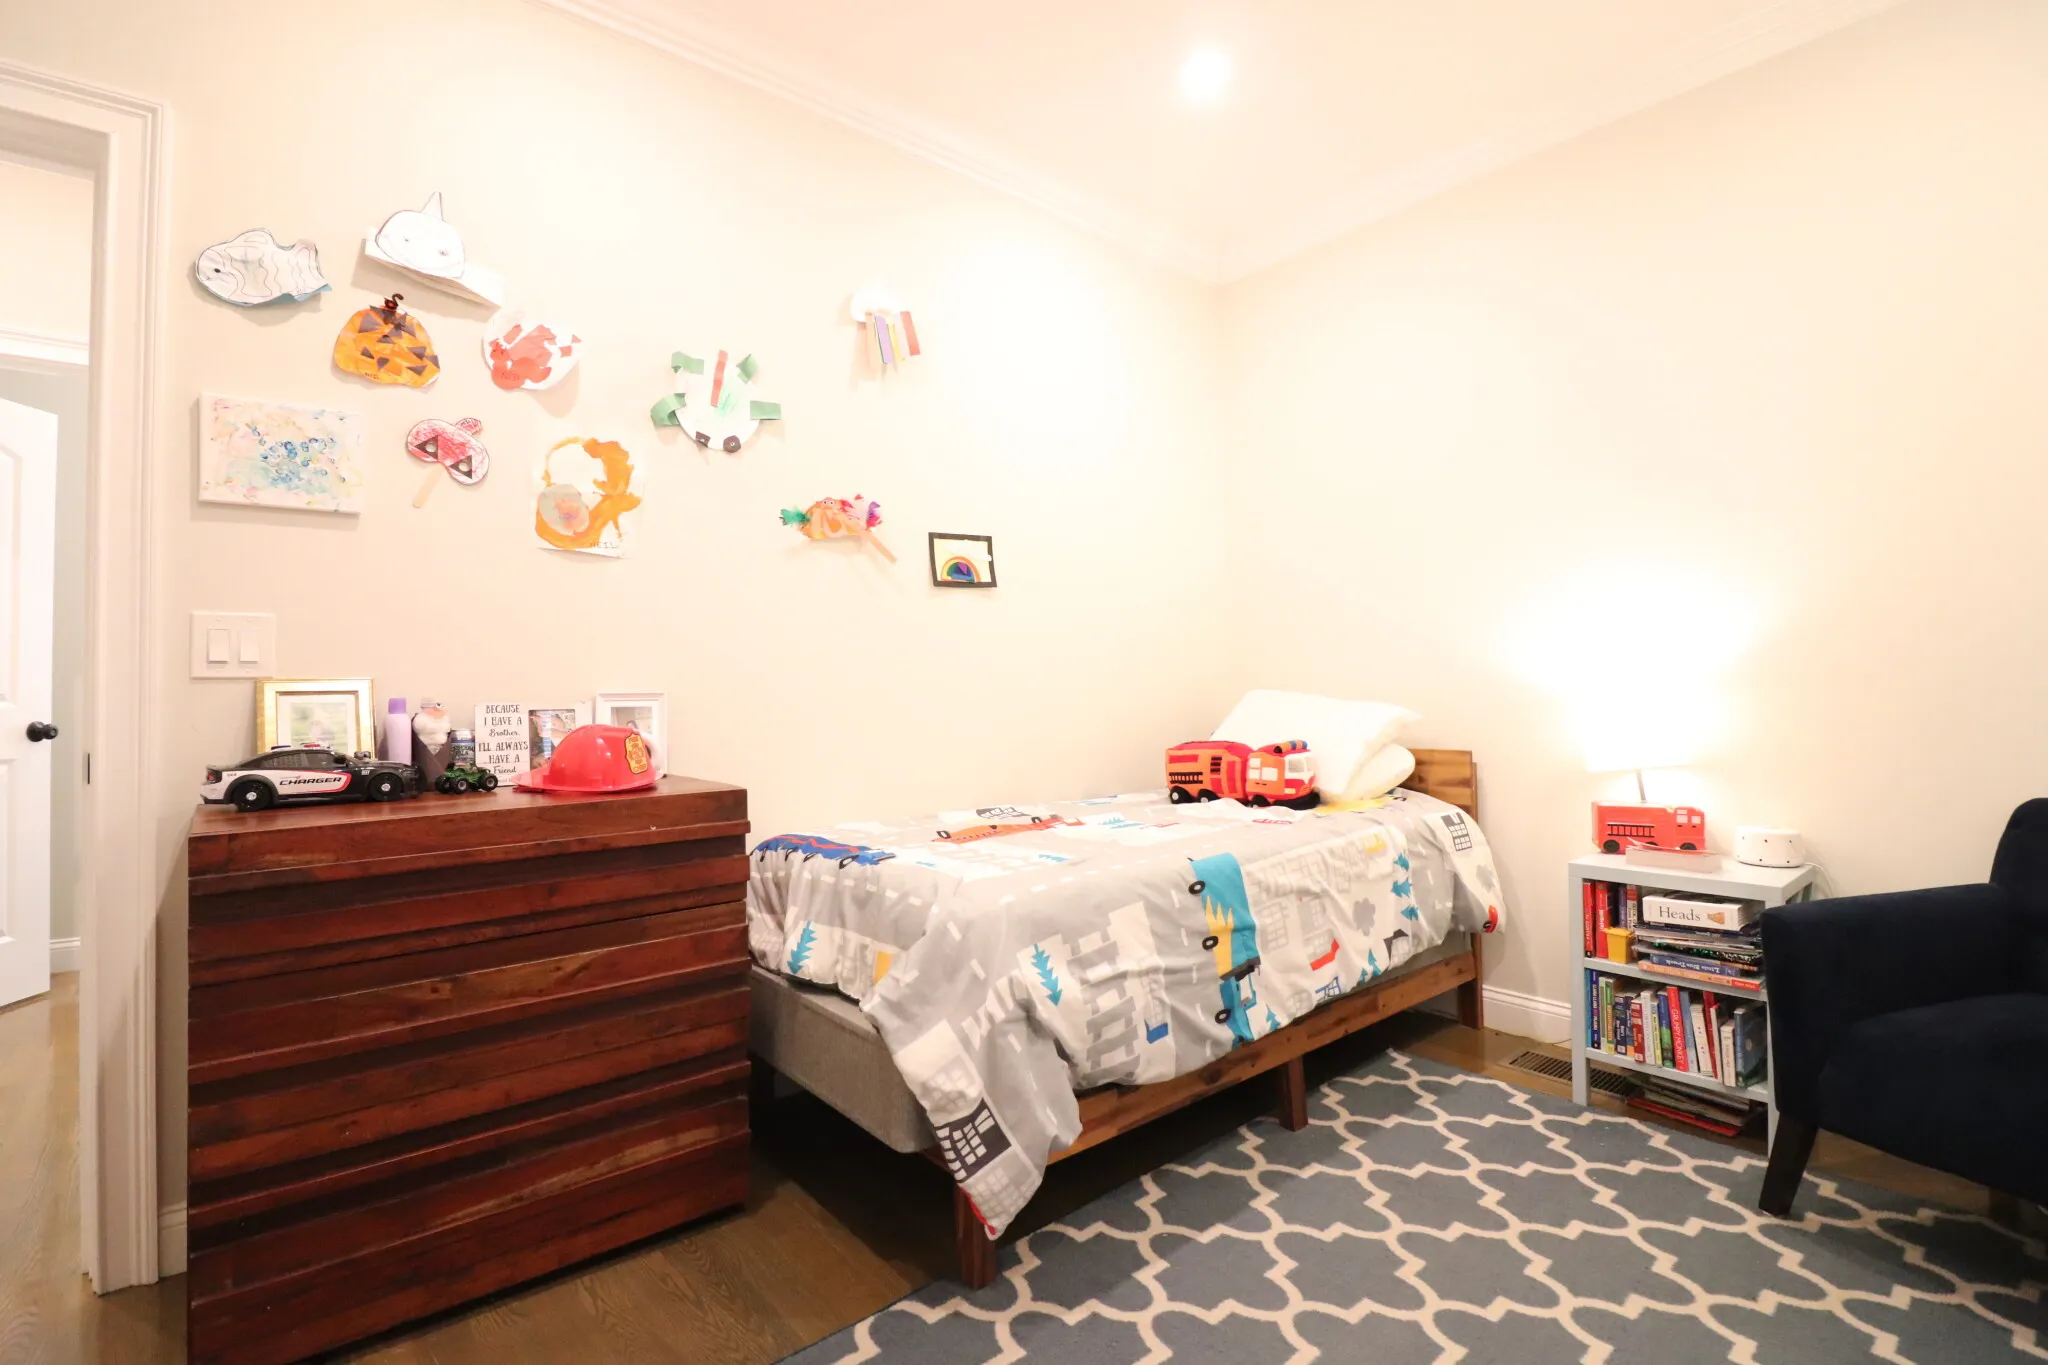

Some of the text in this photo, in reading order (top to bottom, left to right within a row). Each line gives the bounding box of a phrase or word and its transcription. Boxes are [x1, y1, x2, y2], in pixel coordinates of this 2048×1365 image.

[486, 704, 520, 714] BECAUSE
[491, 717, 513, 726] HAVE
[517, 716, 522, 725] A
[496, 741, 528, 751] ALWAYS
[489, 754, 520, 764] HAVE A
[493, 765, 517, 774] Friend
[279, 777, 342, 786] CHARGER
[1659, 905, 1701, 922] Heads
[1671, 1009, 1681, 1036] GRUMPY
[1676, 1037, 1684, 1064] MONKEY
